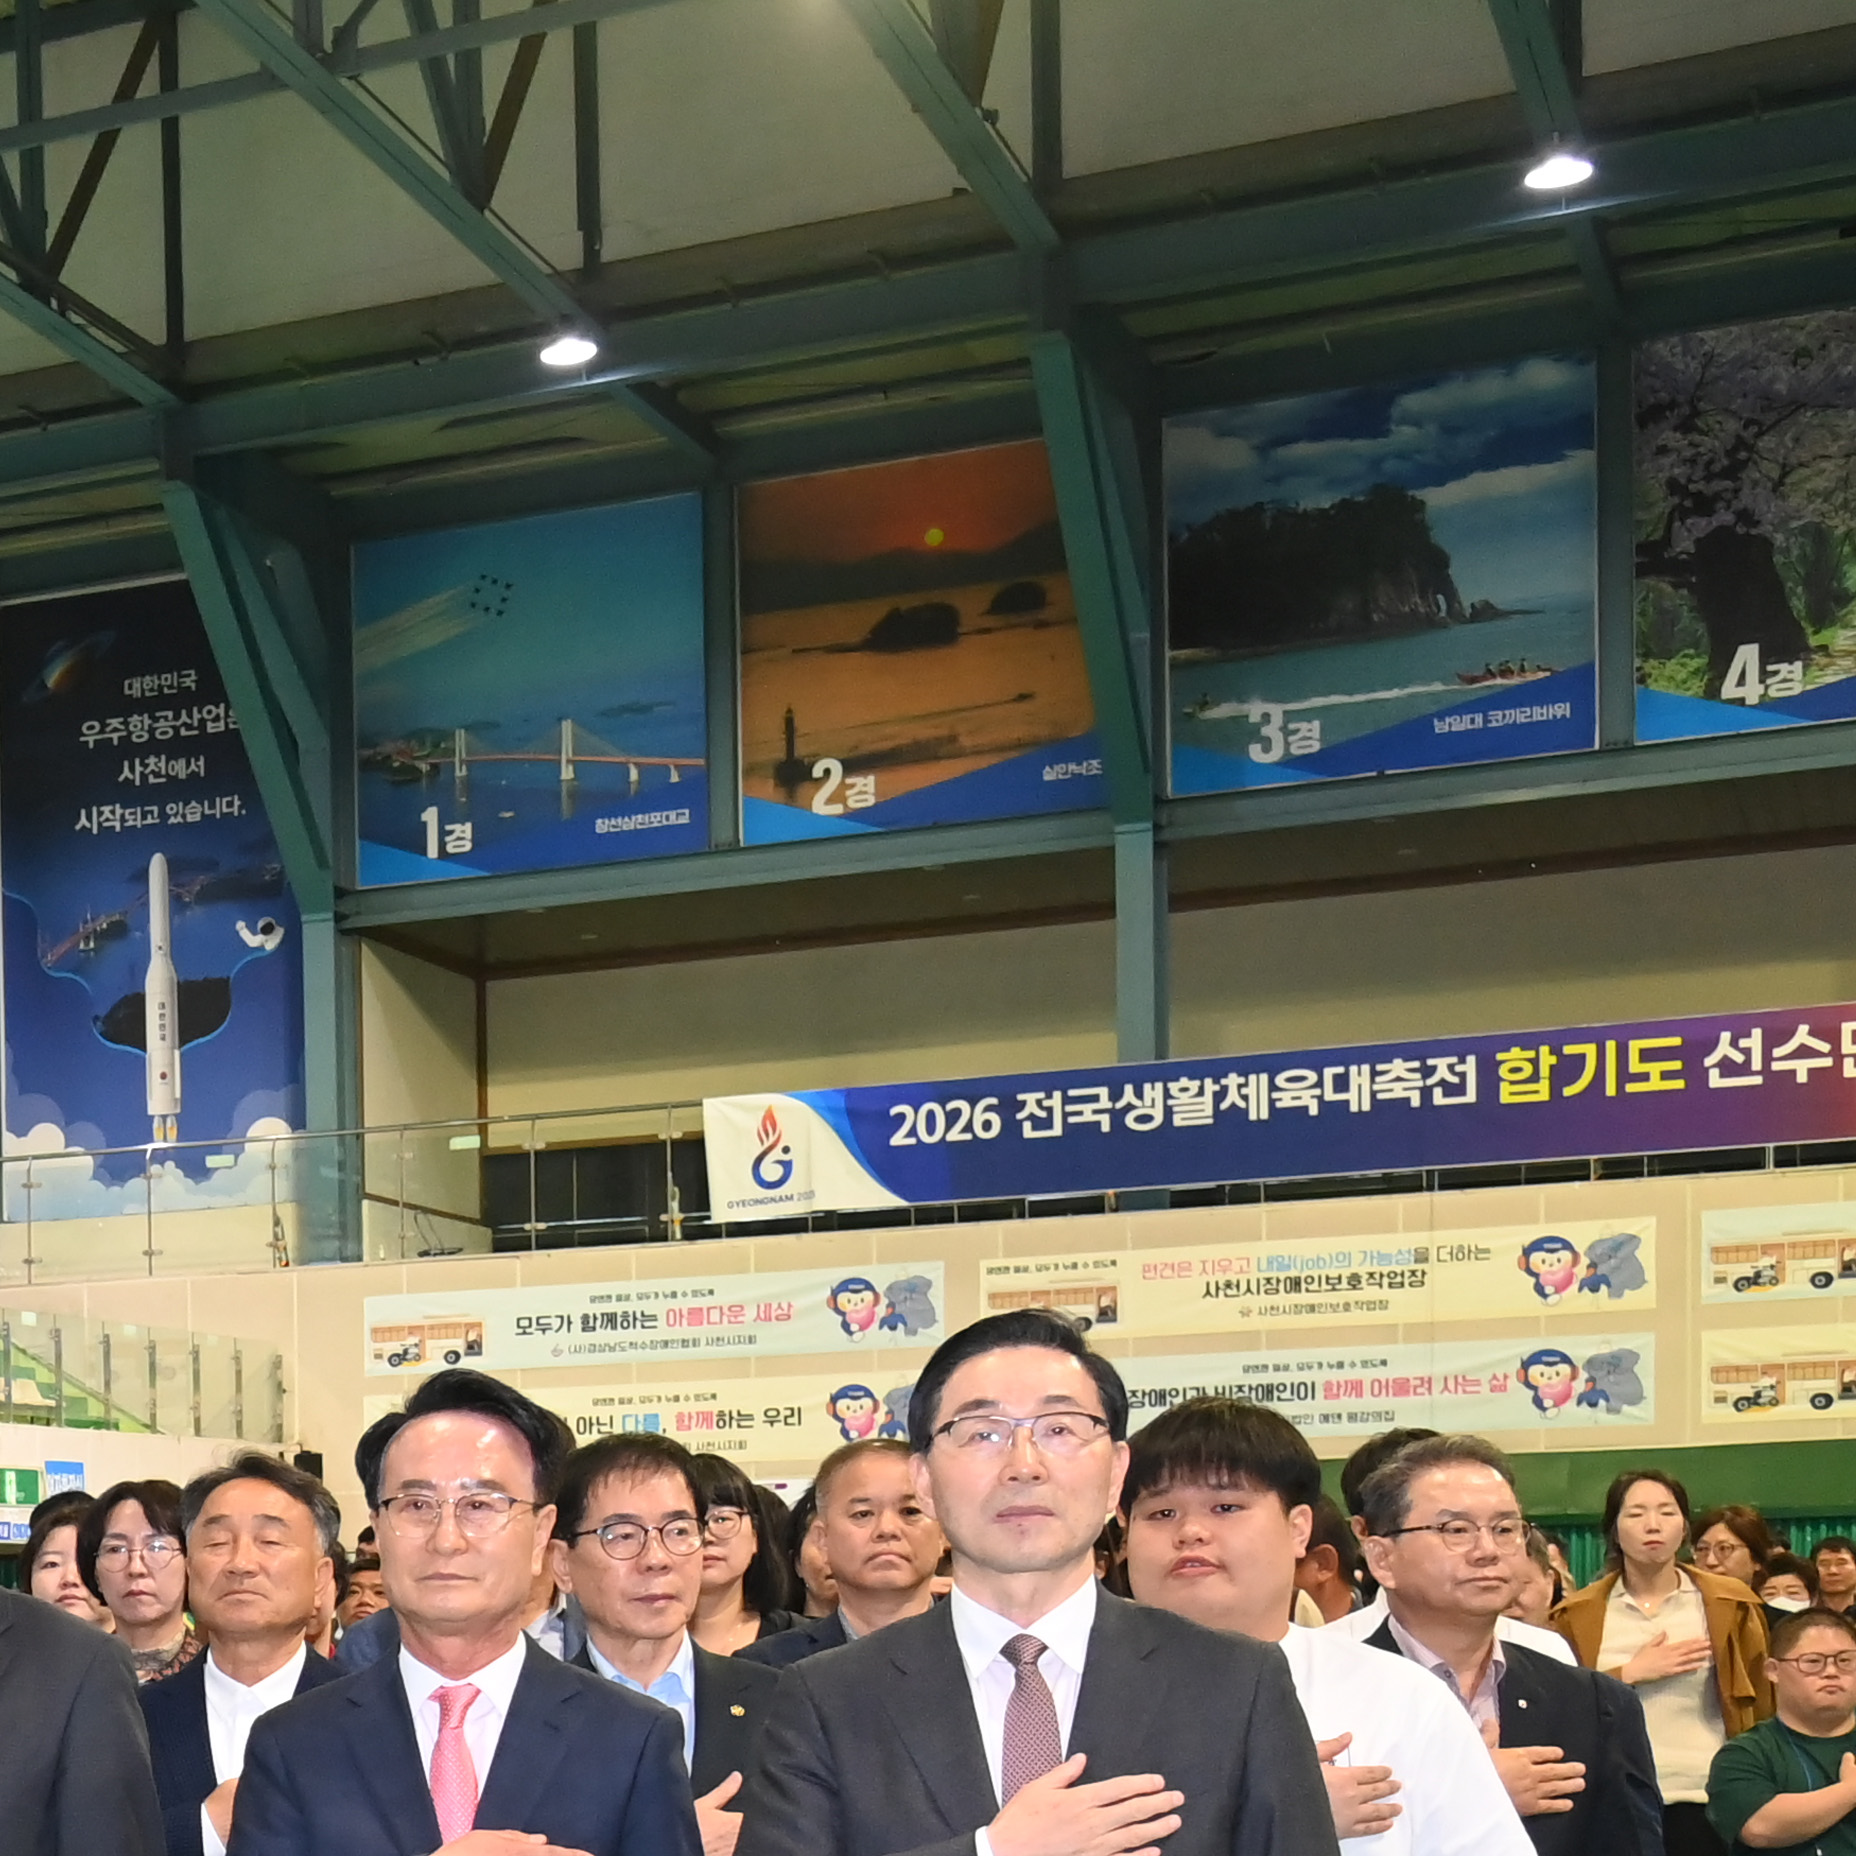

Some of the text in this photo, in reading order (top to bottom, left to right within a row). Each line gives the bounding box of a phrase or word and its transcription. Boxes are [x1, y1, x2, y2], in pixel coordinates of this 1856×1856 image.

[123, 669, 198, 699] 대한민국
[1720, 643, 1805, 705] 4경
[1248, 702, 1321, 764] 3경
[1433, 701, 1571, 734] 남일대 코끼리바위
[117, 754, 206, 787] 사천에서
[811, 757, 877, 816] 2경
[74, 793, 247, 836] 시작되고 있습니다.
[421, 806, 474, 858] 1경
[888, 1018, 1856, 1147] 2026 전국생활체육대축전 합기도 선수
[1142, 1261, 1192, 1280] 편견은
[1199, 1257, 1251, 1276] 지우고
[1436, 1243, 1492, 1263] 더하는
[1202, 1268, 1428, 1300] 사천시장애인보호작업장
[515, 1301, 794, 1336] 모두가 함께하는 아름다운 세상
[1322, 1379, 1364, 1400] 함께
[1370, 1376, 1433, 1398] 어울려
[1441, 1374, 1481, 1394] 사는
[576, 1415, 614, 1436] 아닌
[675, 1408, 755, 1431] 함께하는
[762, 1406, 803, 1427] 우리
